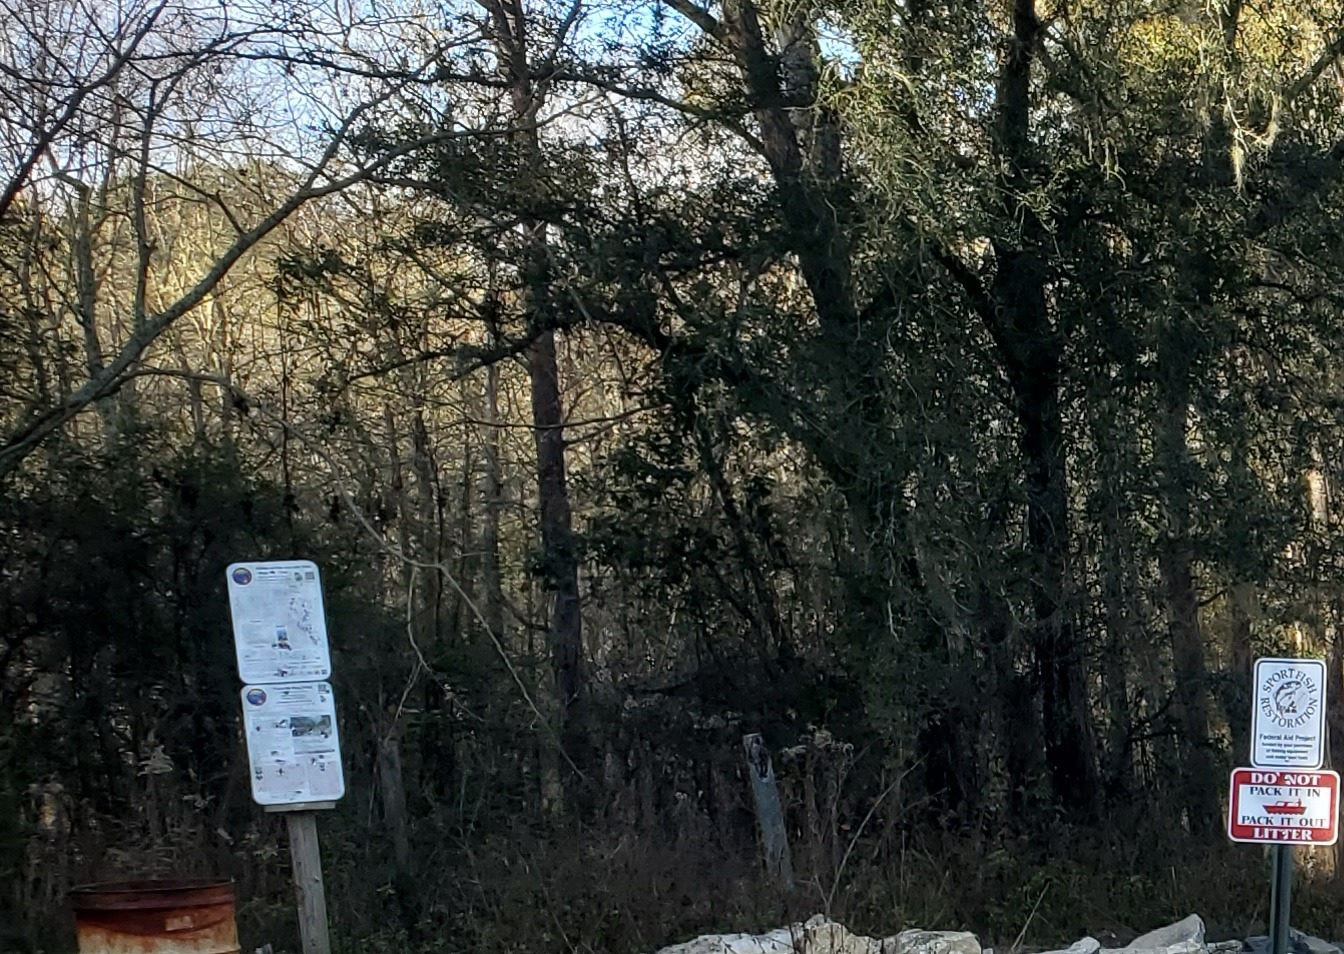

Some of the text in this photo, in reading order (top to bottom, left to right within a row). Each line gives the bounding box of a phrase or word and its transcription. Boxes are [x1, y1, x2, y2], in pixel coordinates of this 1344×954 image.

[1260, 697, 1318, 728] RESTORATION
[1259, 733, 1282, 741] Federal
[1250, 772, 1321, 786] DO NOT
[1250, 786, 1320, 797] PACK IT IN
[1241, 815, 1326, 827] PACK IT OUT
[1253, 827, 1313, 840] LITTER
